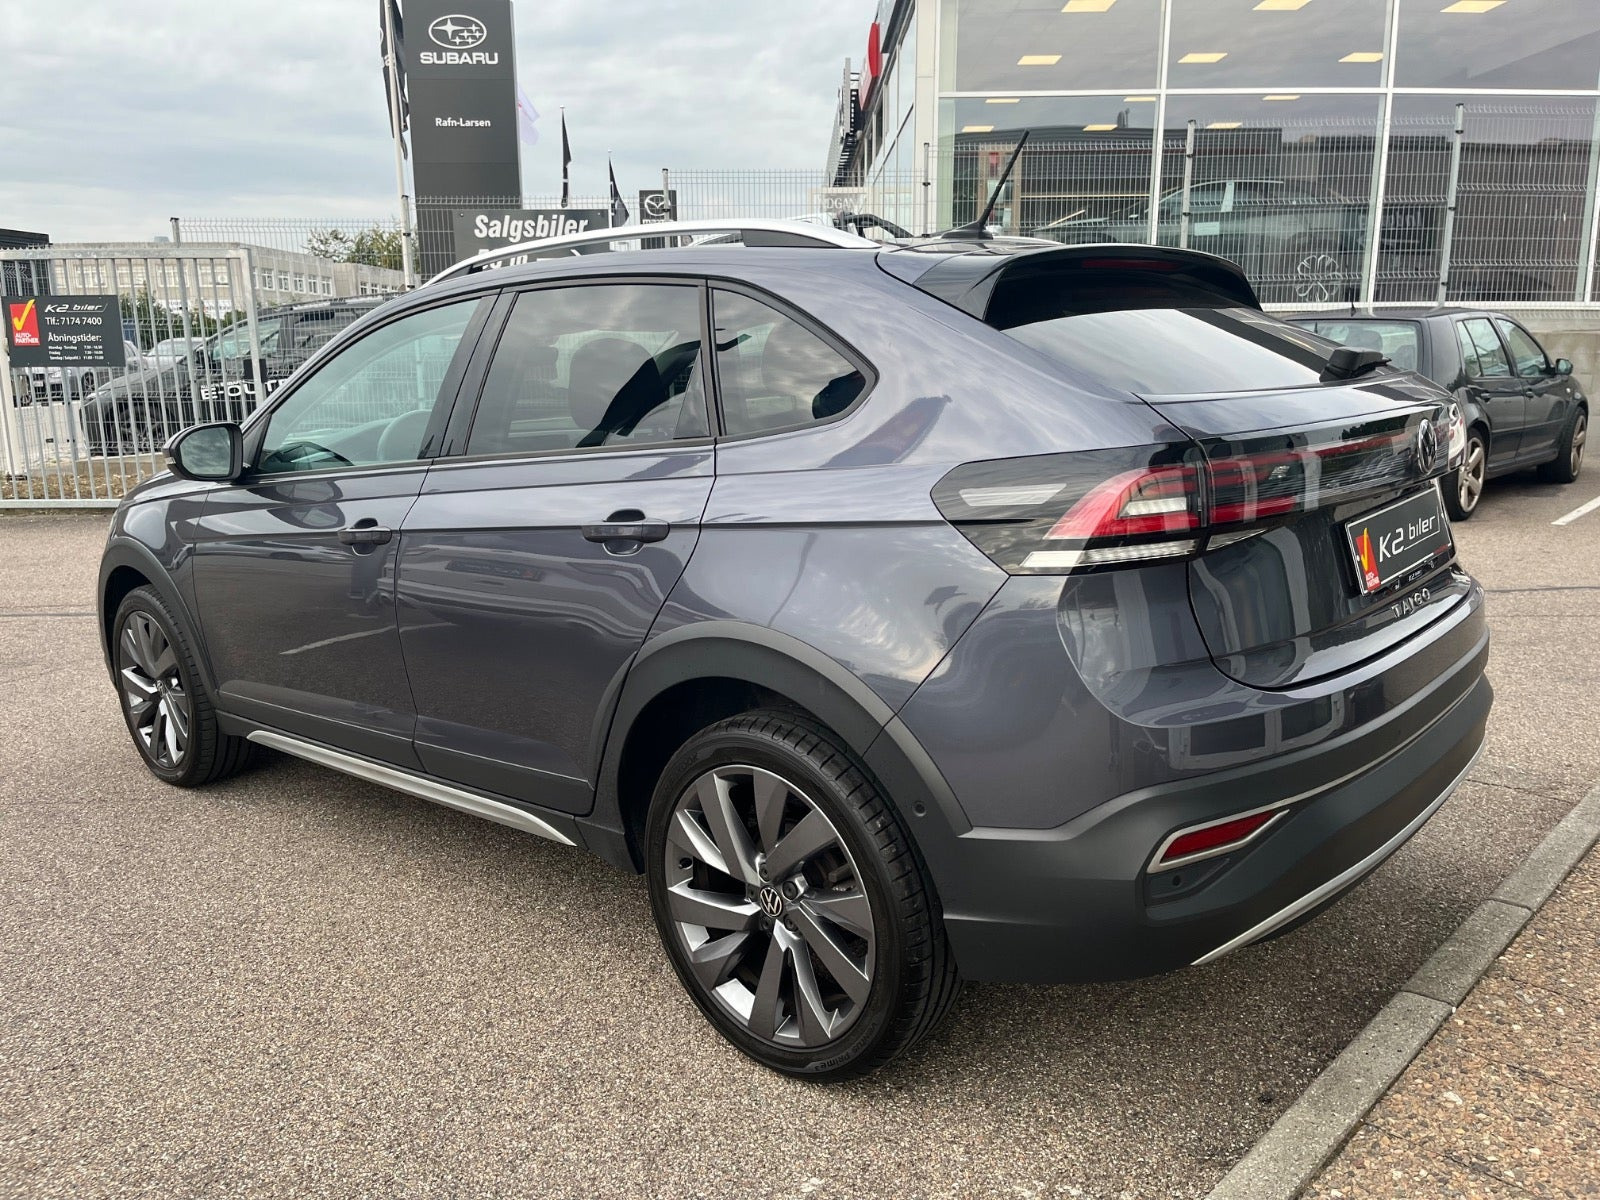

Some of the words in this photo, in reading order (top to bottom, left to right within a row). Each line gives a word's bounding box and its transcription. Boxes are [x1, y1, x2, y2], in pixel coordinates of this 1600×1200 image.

[420, 52, 498, 65] SUBARU
[435, 117, 491, 127] Rafn-Larsen
[474, 214, 588, 243] Salgsbiler
[44, 304, 69, 312] K2
[45, 317, 60, 325] Tlf.:
[61, 317, 81, 325] 7174
[82, 317, 102, 325] 7400
[48, 332, 102, 344] Åbningstider:
[1379, 527, 1405, 563] K2
[1408, 514, 1436, 540] biler
[1391, 587, 1431, 619] TAIGO
